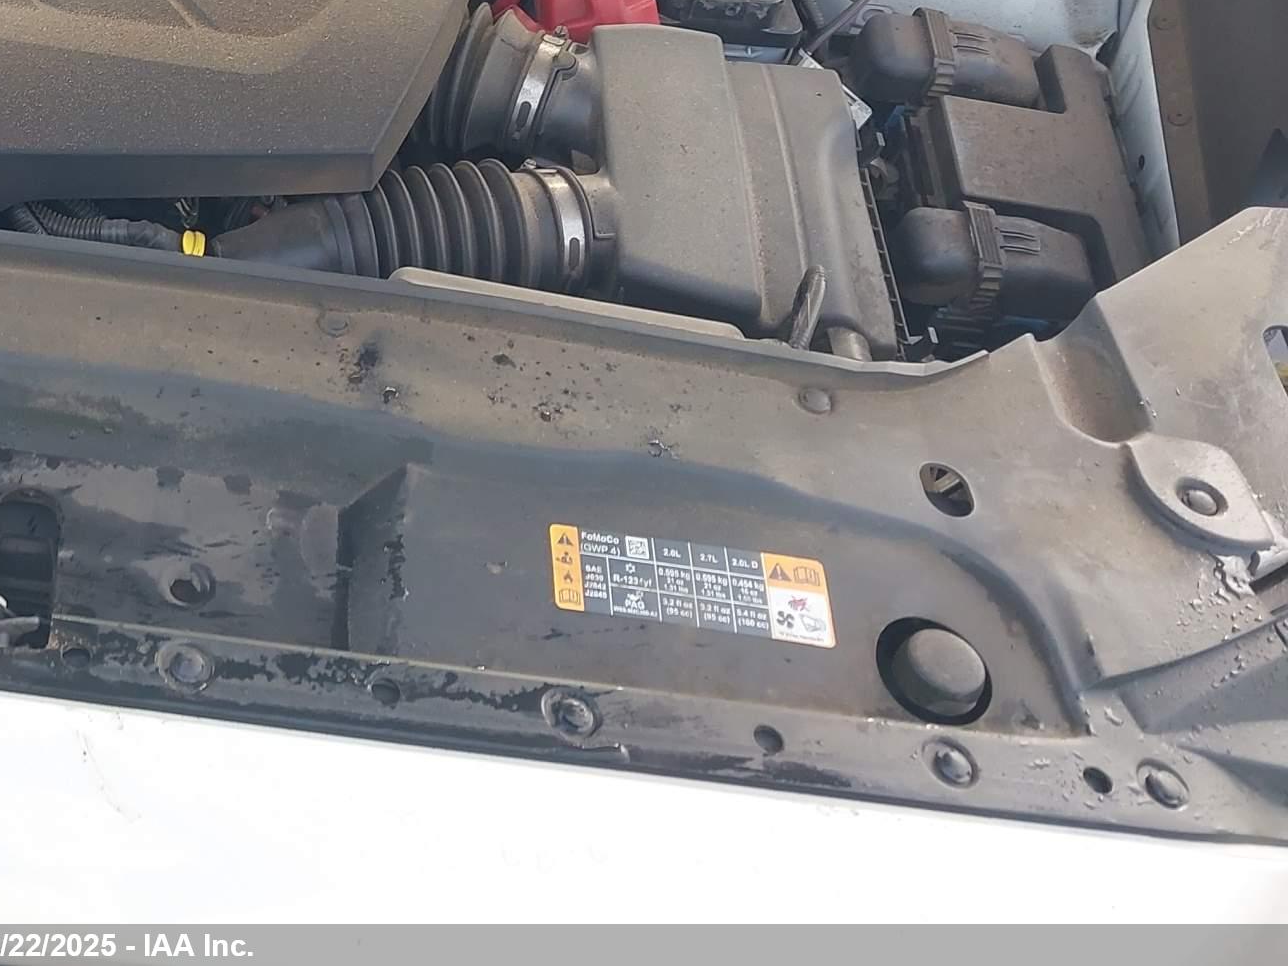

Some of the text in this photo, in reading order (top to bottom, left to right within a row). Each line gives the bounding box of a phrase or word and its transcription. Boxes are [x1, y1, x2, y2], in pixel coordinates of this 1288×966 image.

[581, 531, 620, 545] FoMoCo
[580, 541, 621, 558] (GWP 4)
[662, 547, 682, 558] 2.0L
[699, 553, 719, 563] 2.7L
[731, 557, 750, 568] 2.0L
